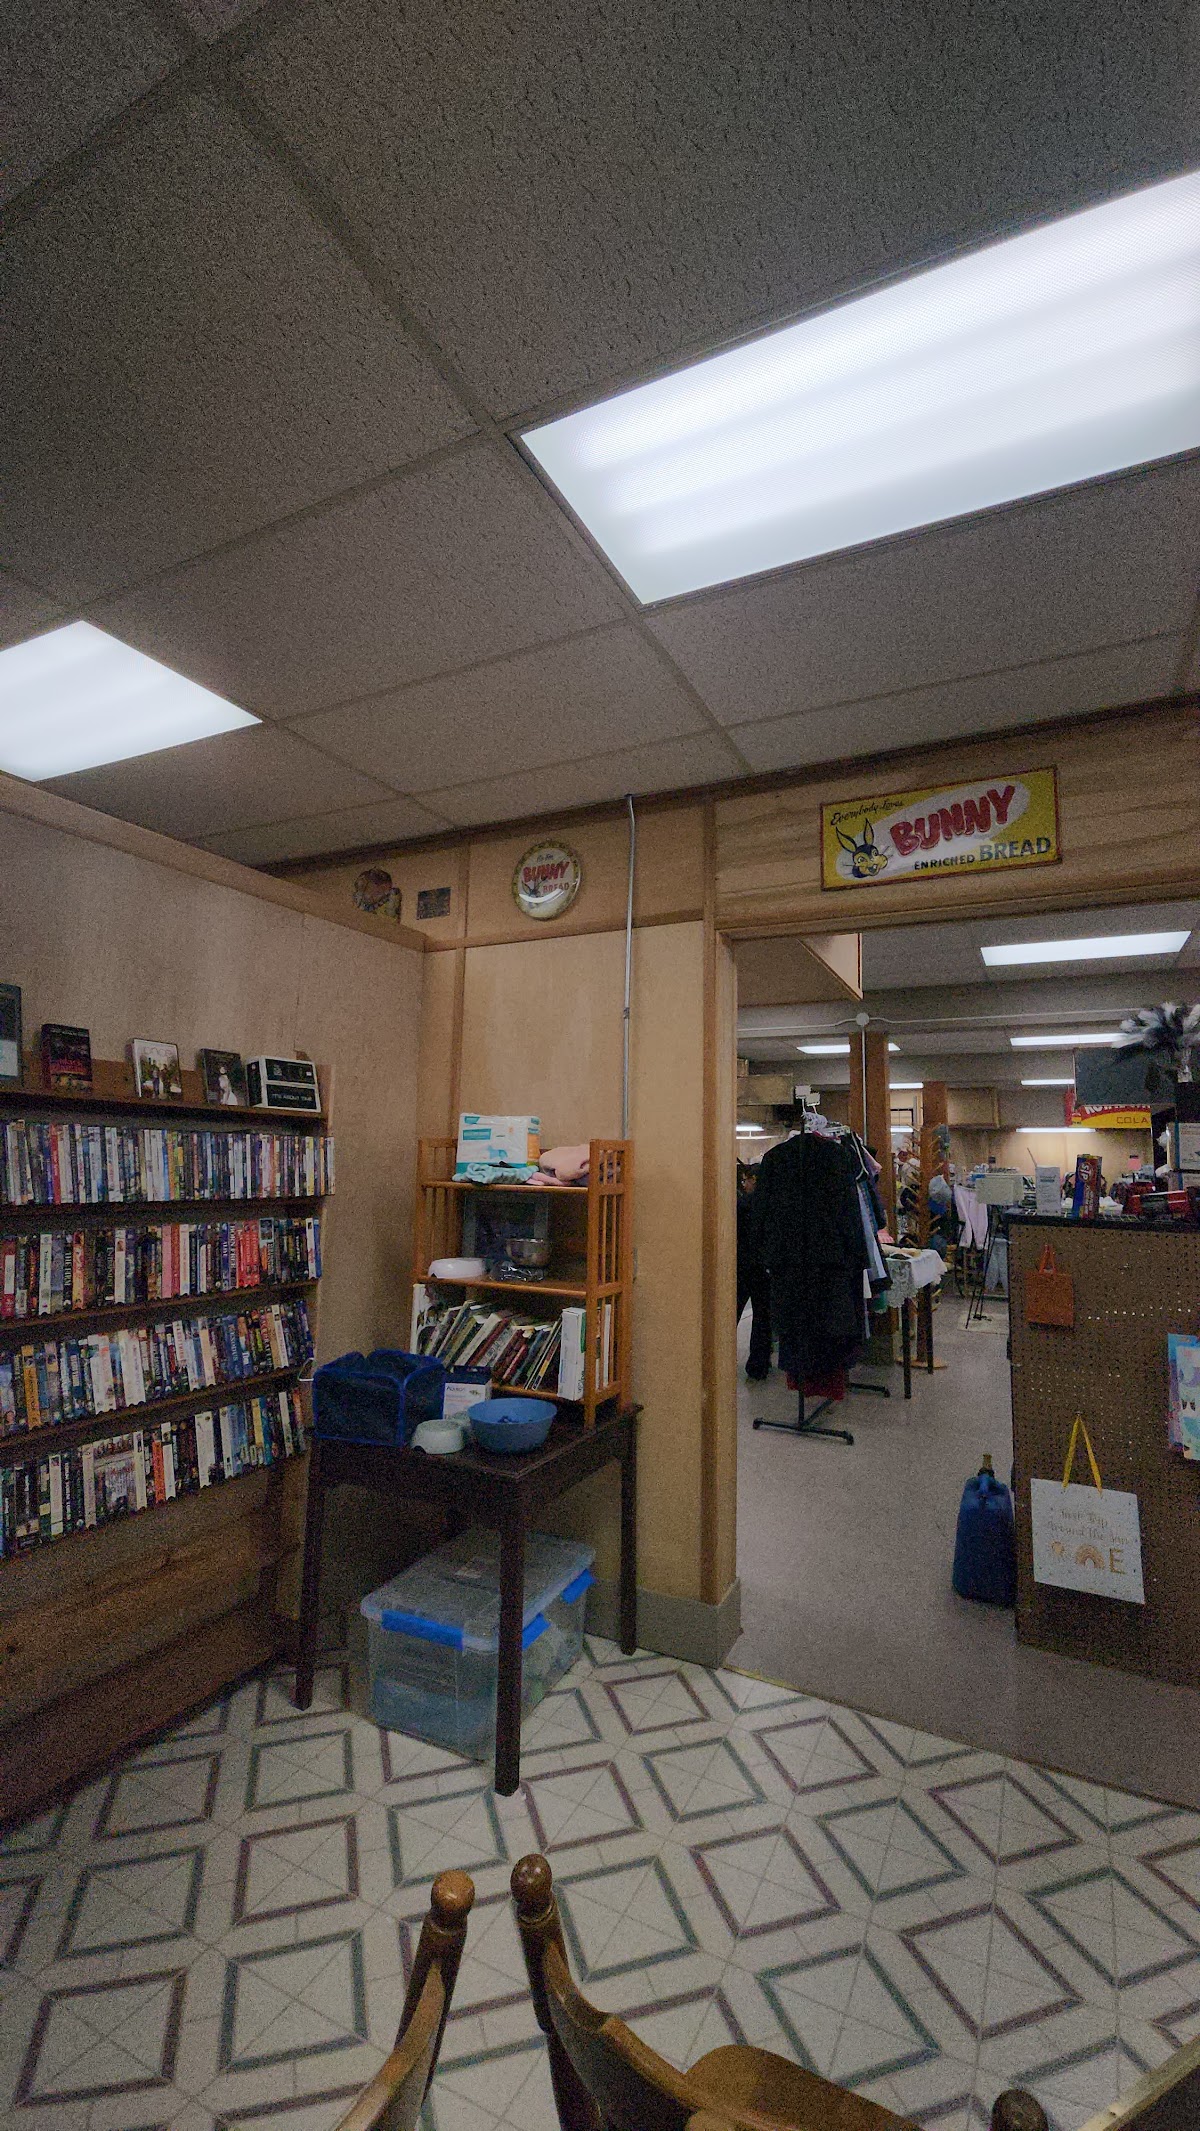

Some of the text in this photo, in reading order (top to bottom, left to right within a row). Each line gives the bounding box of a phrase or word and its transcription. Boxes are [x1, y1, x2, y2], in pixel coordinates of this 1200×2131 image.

[830, 801, 879, 826] Everybody
[890, 784, 1016, 857] BUNNY
[914, 837, 1051, 870] ENRICHED BREAD
[523, 860, 570, 883] BUNNY
[1116, 1116, 1149, 1124] COLA
[1079, 1162, 1092, 1180] STP
[1109, 1548, 1126, 1574] E
